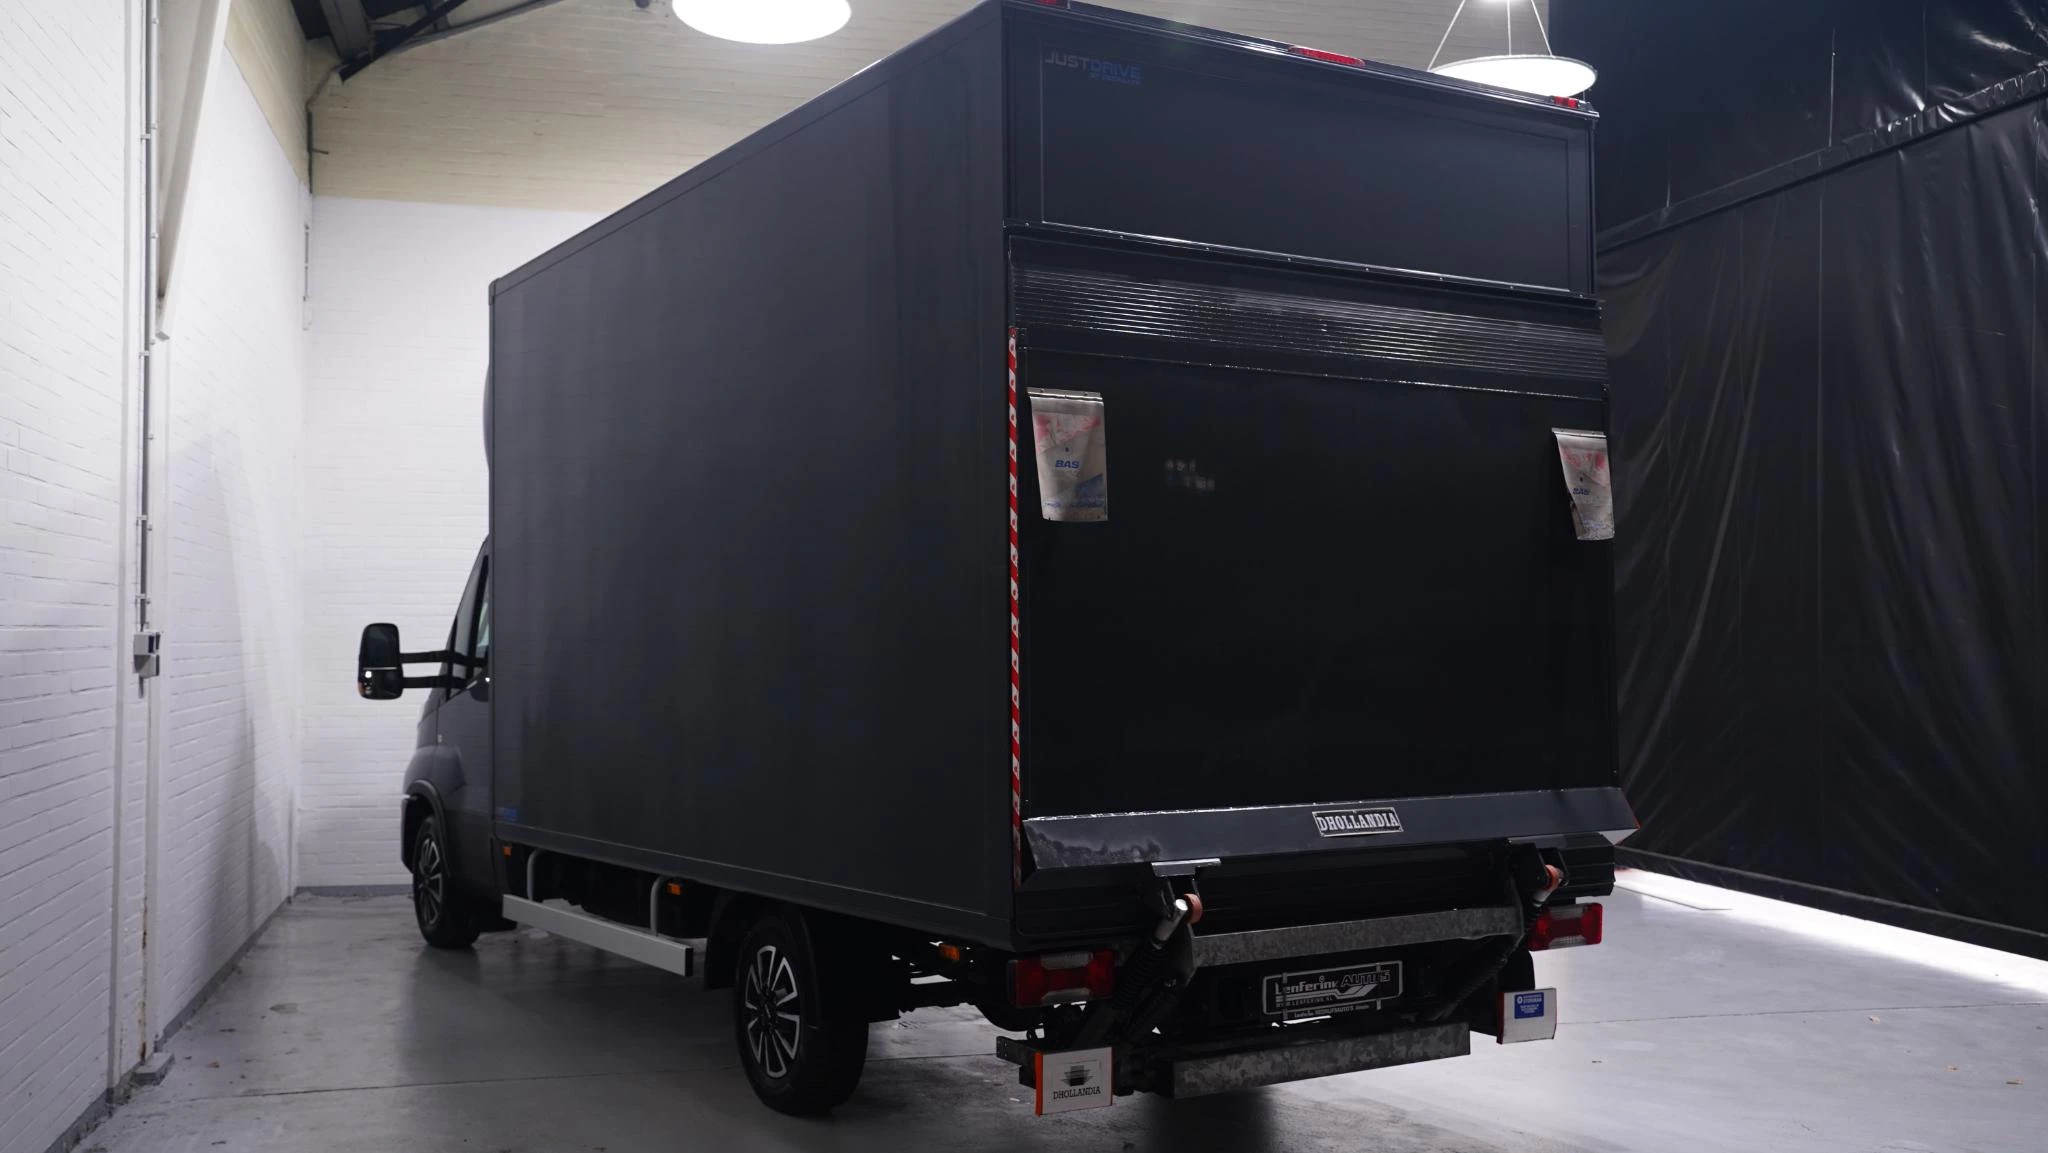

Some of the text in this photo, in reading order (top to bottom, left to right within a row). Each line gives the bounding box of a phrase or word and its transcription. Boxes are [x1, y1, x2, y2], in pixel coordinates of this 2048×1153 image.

[1055, 459, 1080, 469] BAS
[1316, 812, 1399, 831] DHOLLANDIA
[1053, 1086, 1101, 1100] DHOLLANDIA
